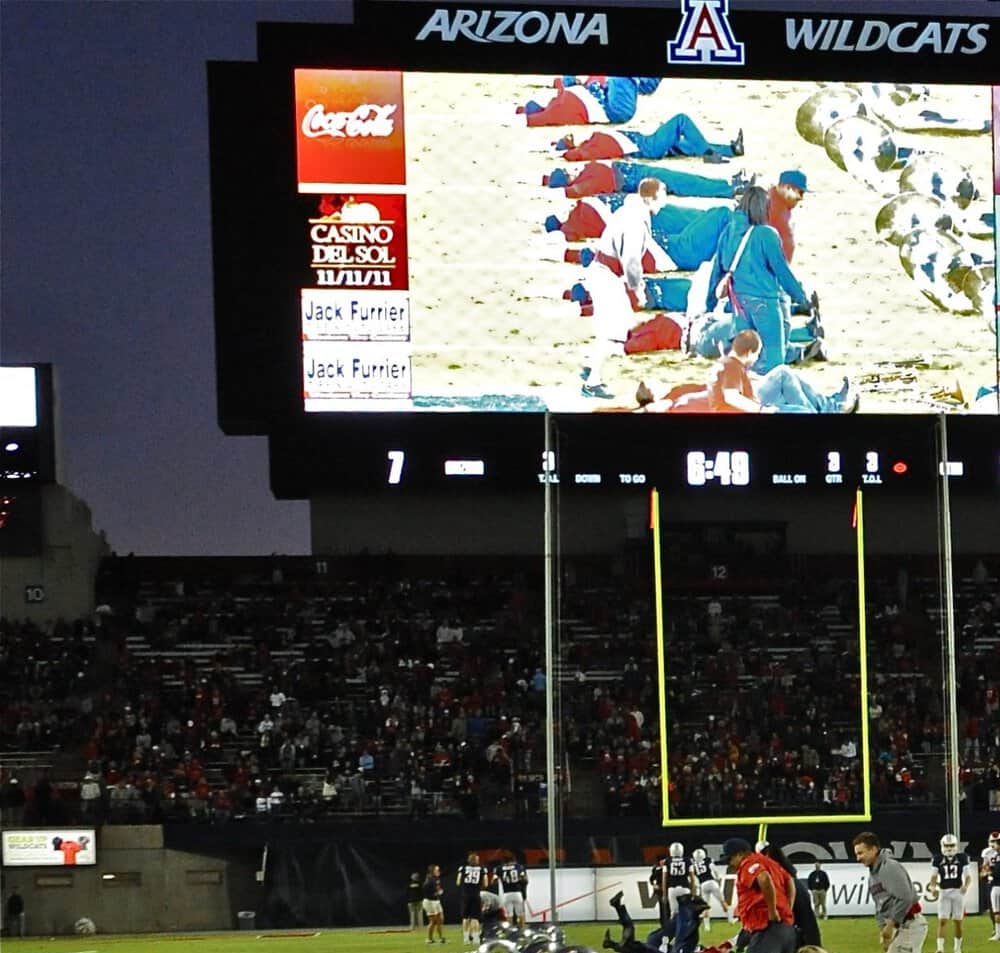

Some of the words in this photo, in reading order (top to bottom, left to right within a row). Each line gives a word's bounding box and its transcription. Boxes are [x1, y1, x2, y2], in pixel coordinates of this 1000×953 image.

[415, 9, 609, 45] ARIZONA
[667, 0, 745, 65] A
[785, 18, 990, 54] WILDCATS
[310, 225, 393, 243] CASINO
[312, 245, 354, 263] DEL
[355, 245, 396, 263] SOL
[317, 270, 391, 285] 11/11/11
[306, 300, 343, 321] Jack
[351, 300, 404, 321] Furrier
[308, 359, 345, 379] Jack
[353, 359, 406, 379] Furrier
[388, 451, 404, 484] 7
[712, 565, 726, 579] 12
[27, 588, 44, 600] 10
